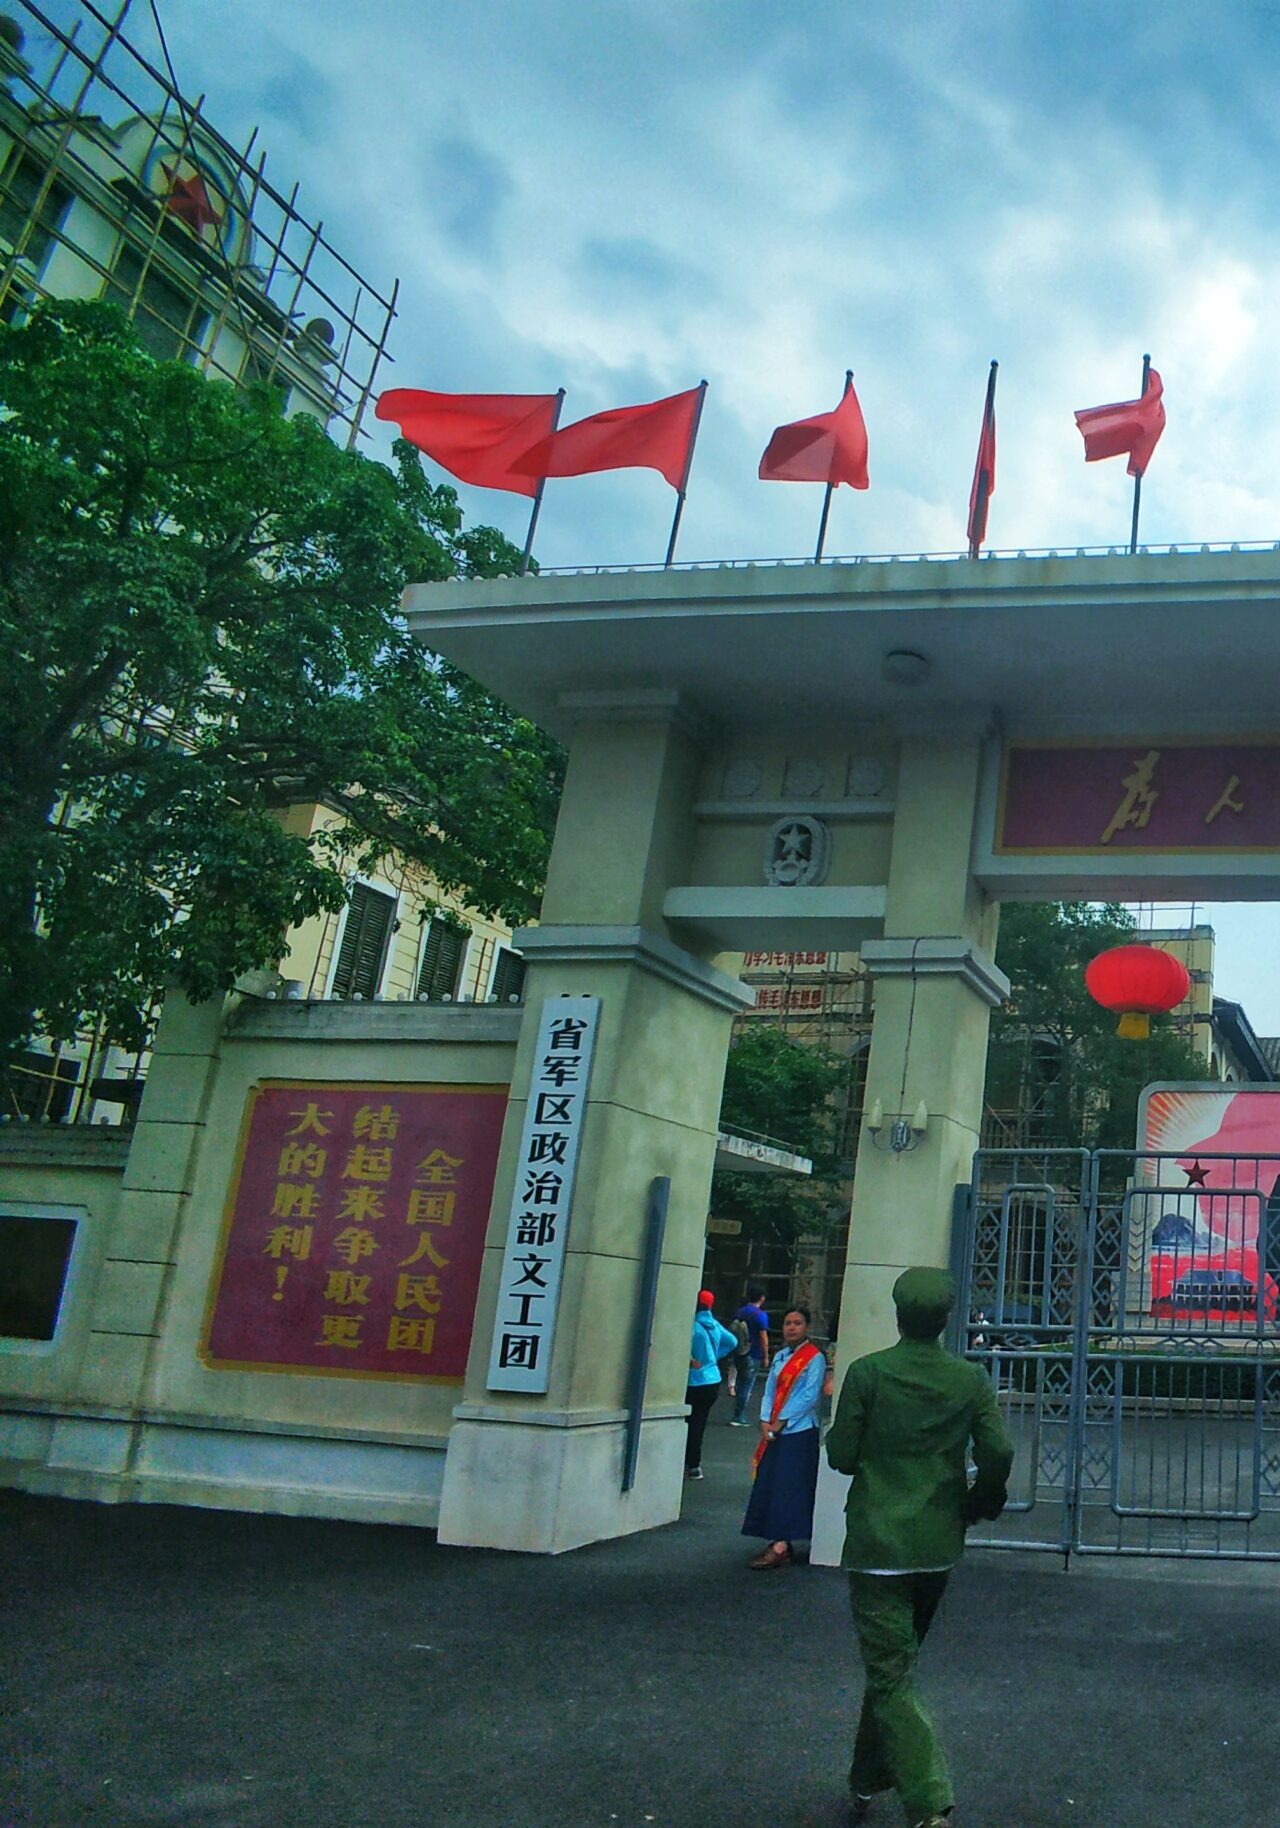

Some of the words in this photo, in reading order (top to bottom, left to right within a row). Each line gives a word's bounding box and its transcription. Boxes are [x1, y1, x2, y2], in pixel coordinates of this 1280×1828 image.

[315, 1104, 400, 1350] 结起来争取更
[386, 1148, 464, 1354] 全国人民团
[499, 1018, 588, 1370] 省军区政治部文工团
